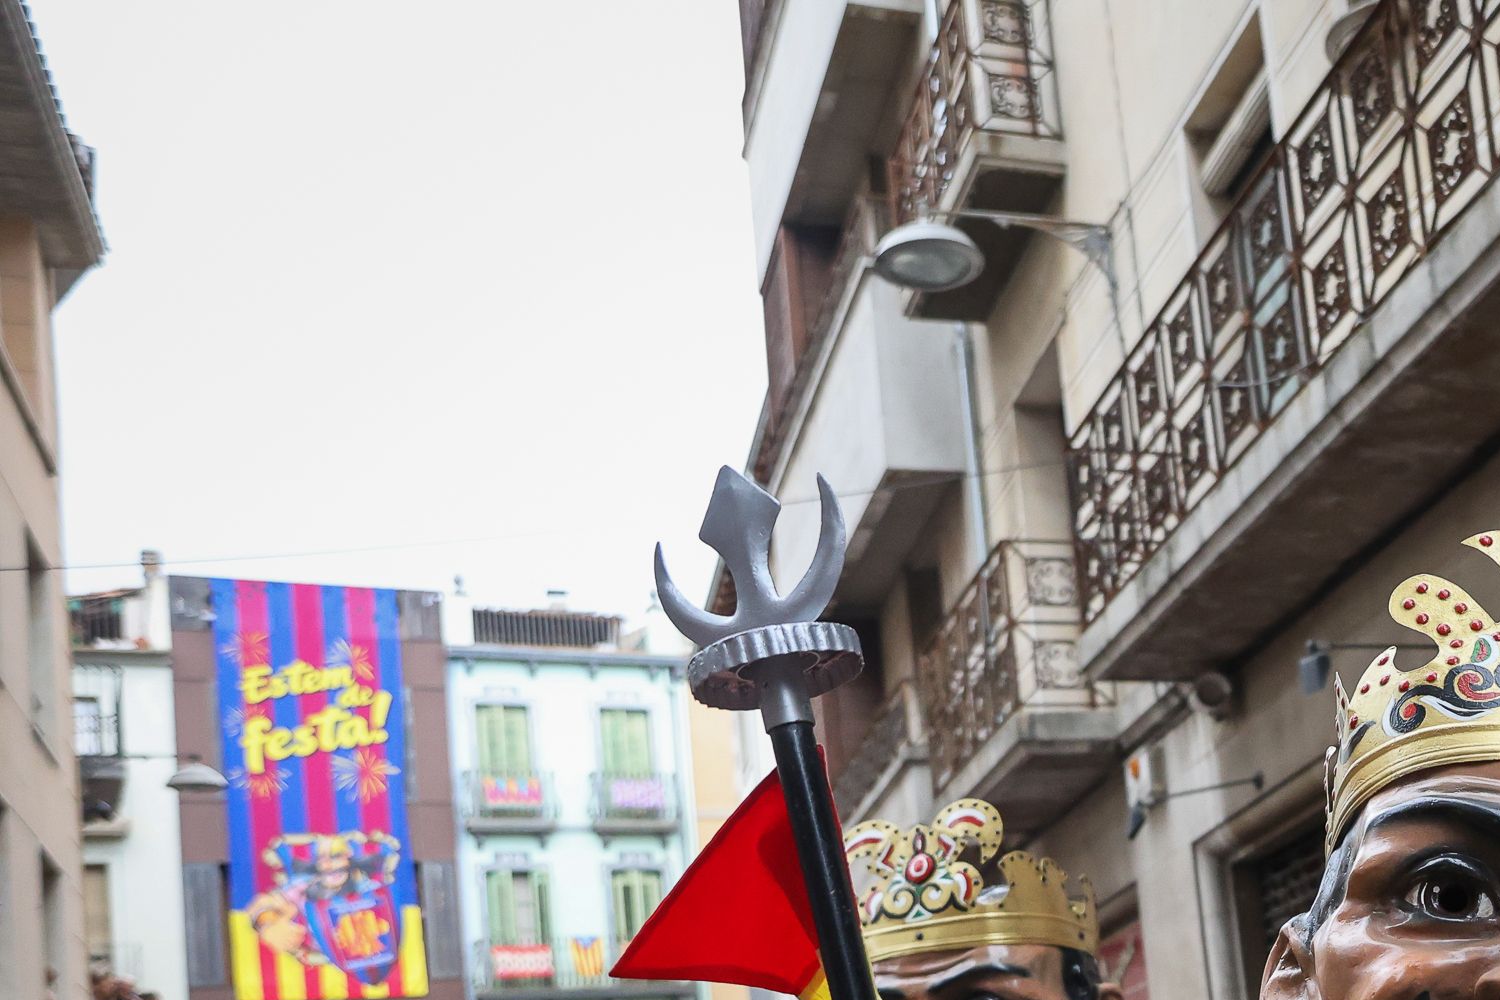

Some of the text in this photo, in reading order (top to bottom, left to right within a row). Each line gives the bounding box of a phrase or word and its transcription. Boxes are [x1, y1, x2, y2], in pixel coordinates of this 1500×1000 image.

[239, 658, 353, 704] Estem
[336, 684, 374, 709] de
[242, 690, 393, 774] festa!
